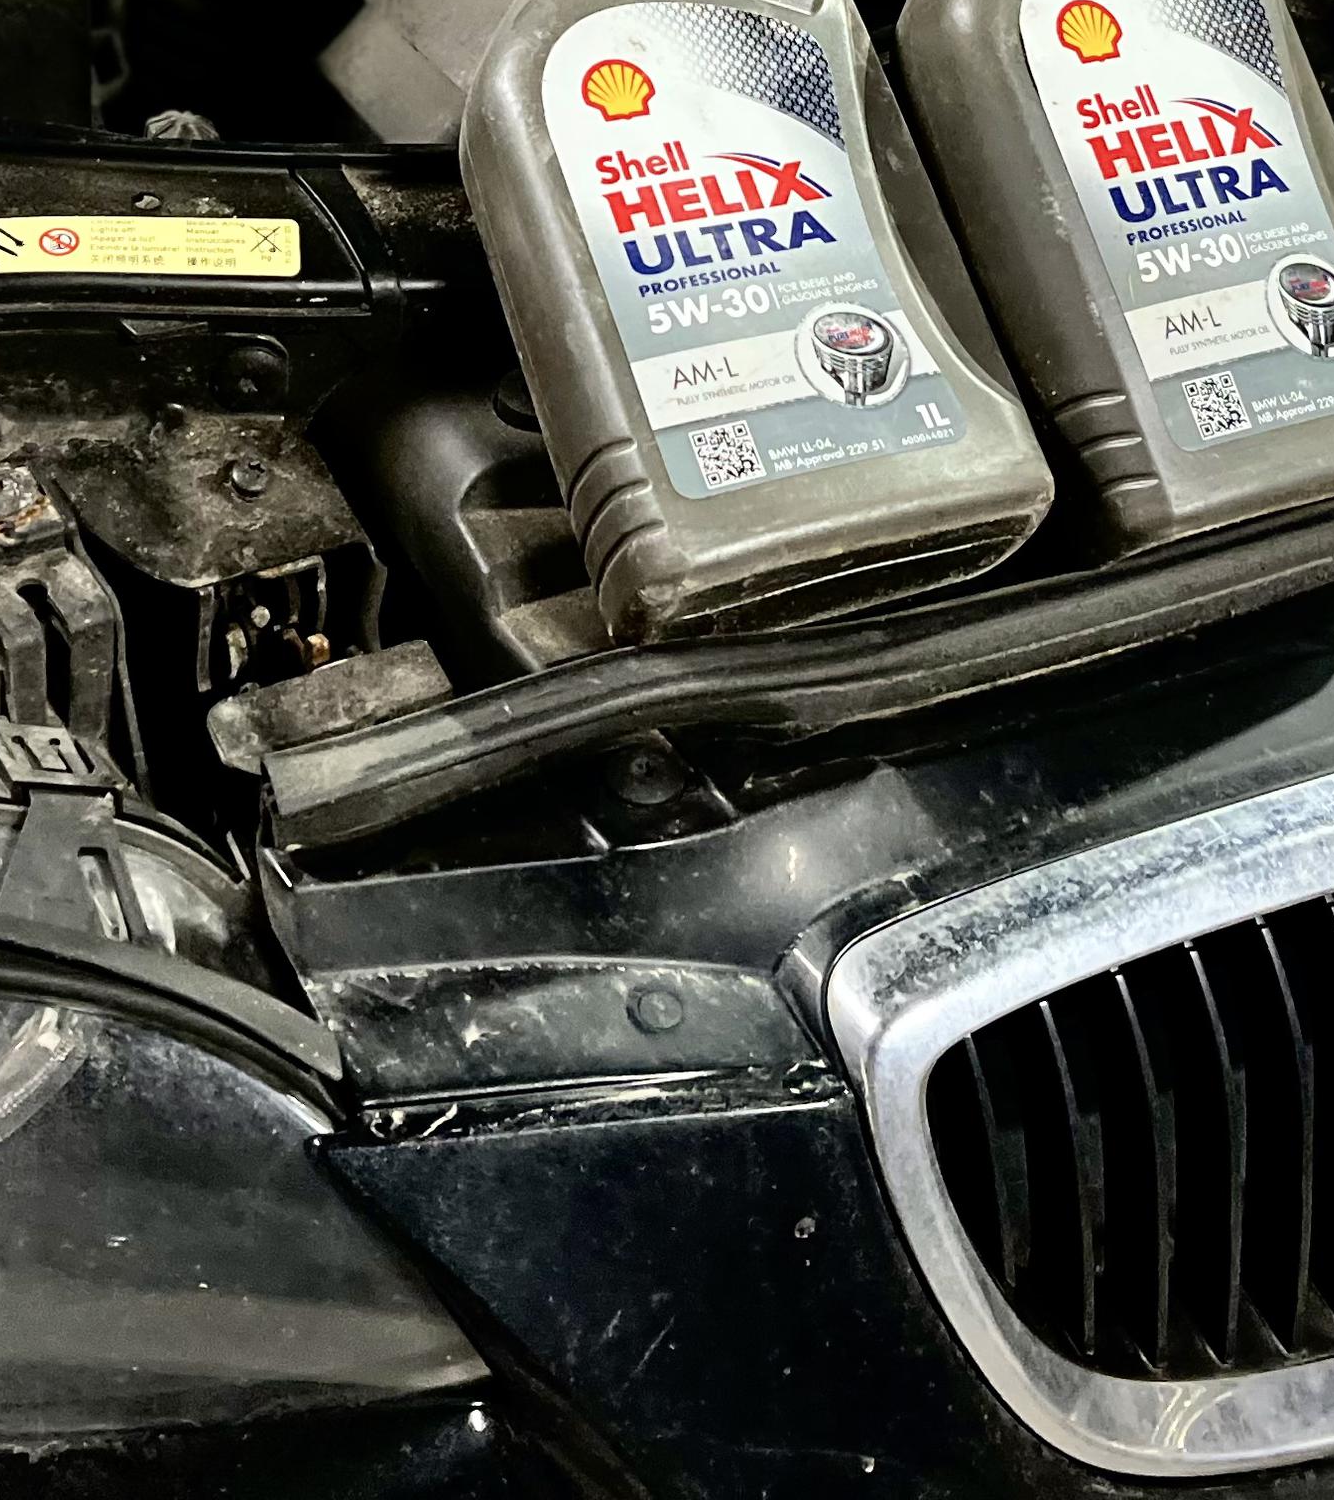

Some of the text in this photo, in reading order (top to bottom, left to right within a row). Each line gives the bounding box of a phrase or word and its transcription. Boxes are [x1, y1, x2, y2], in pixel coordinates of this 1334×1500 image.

[1076, 85, 1160, 130] Shell
[1086, 107, 1282, 180] HELIX
[595, 141, 689, 185] Shell
[602, 160, 832, 234] HELIX
[1108, 158, 1290, 224] ULTRA
[622, 210, 837, 276] ULTRA
[1127, 210, 1247, 246] PROFESSIONAL
[1246, 222, 1309, 243] FOR DIESEL AND
[1250, 230, 1328, 255] GASOLINE ENGINES
[1136, 233, 1242, 284] 5W-30
[638, 261, 781, 298] PROFESSIONAL
[777, 271, 857, 294] FOR DIESEL AND
[780, 278, 879, 305] GASOLINE ENGINES
[647, 283, 769, 334] 5W-30
[1164, 307, 1223, 340] AM-L
[1169, 326, 1271, 357] FULLY SYNTHETIC MOTOR OIL
[672, 356, 740, 390] AM-L
[676, 374, 797, 406] FULLY SYNTHETIC MOTOR OIL
[915, 402, 951, 429] 1L
[1251, 396, 1277, 413] BMW
[768, 443, 799, 461] BMW
